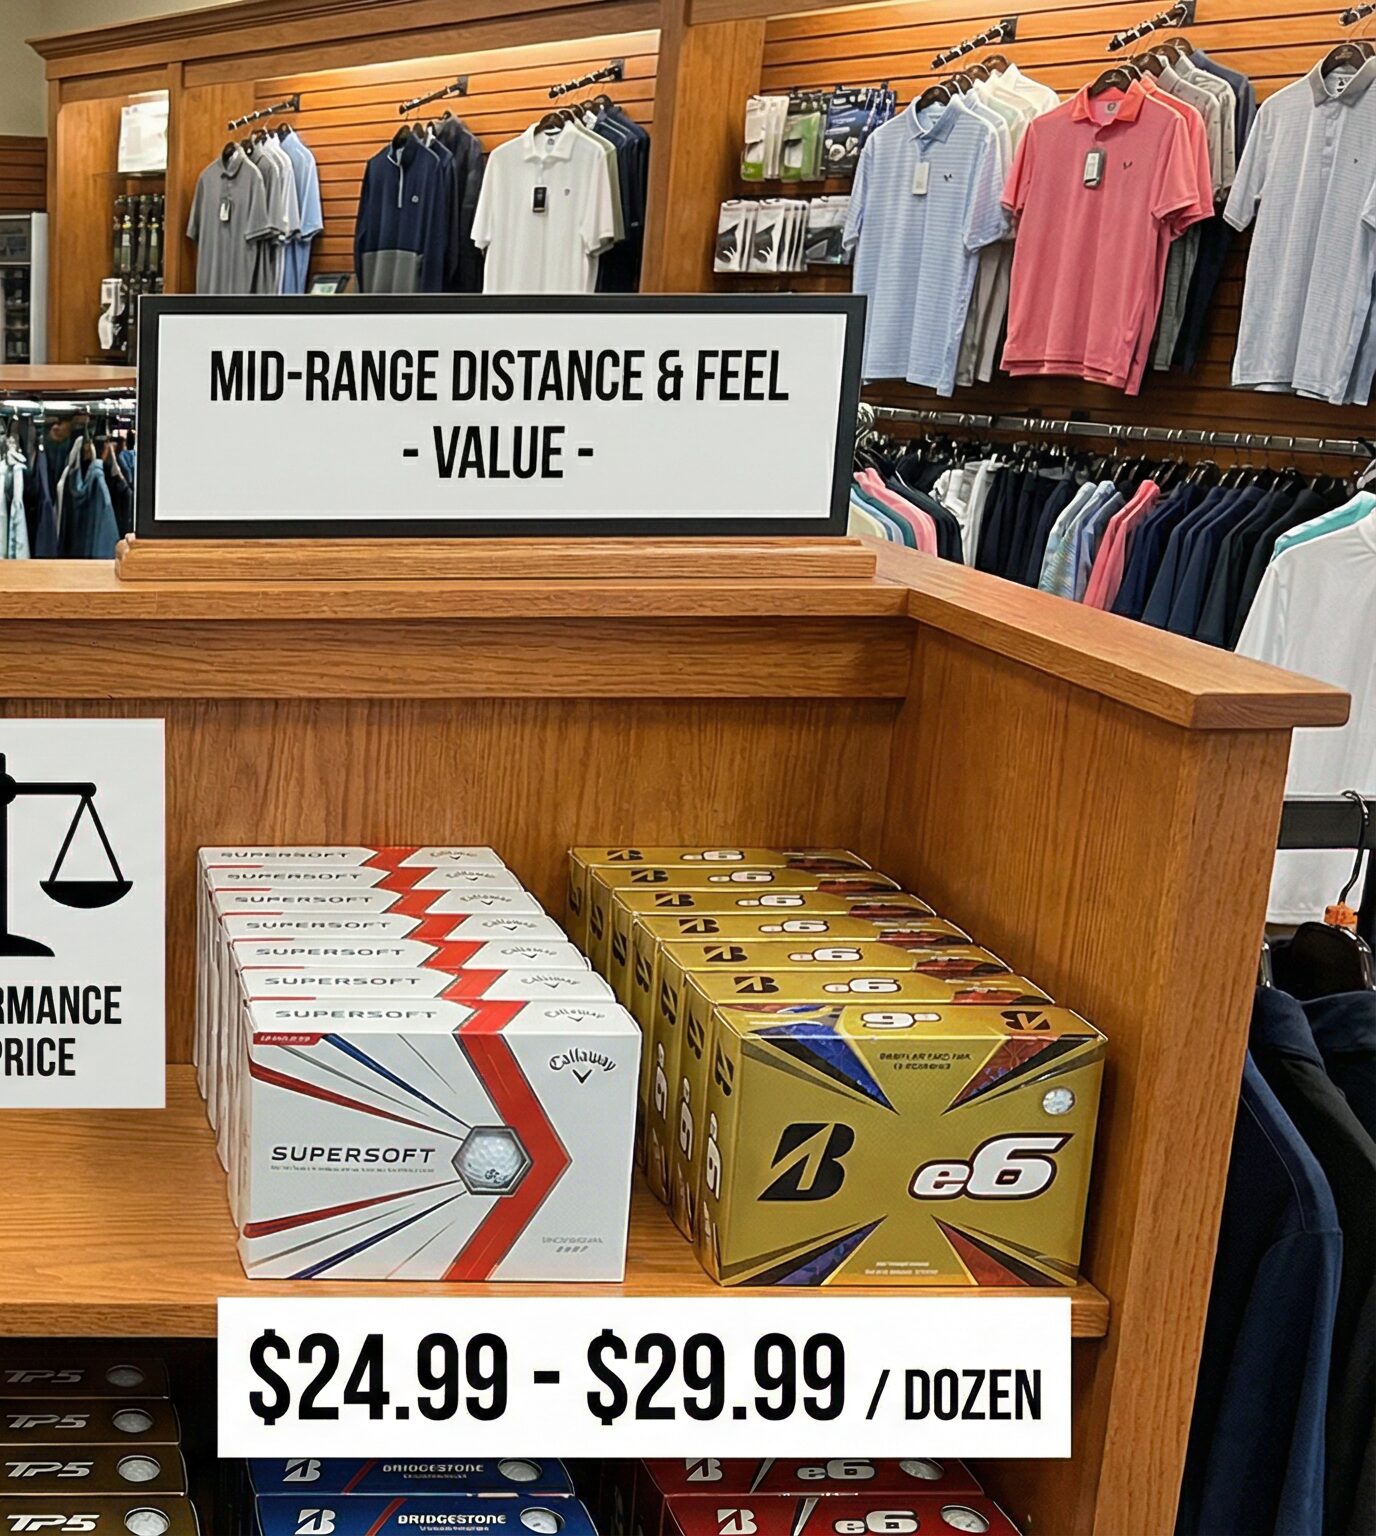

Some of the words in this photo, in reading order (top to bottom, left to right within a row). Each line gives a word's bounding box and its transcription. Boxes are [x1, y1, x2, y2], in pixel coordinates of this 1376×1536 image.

[211, 350, 438, 401] MID-RANGE
[452, 350, 644, 401] DISTANCE
[658, 350, 683, 401] &
[696, 350, 788, 400] FEEL
[433, 426, 565, 478] VALUE
[235, 896, 374, 904] SUPERSOFT
[246, 921, 391, 930] SUPERSOFT
[256, 947, 405, 957] SUPERSOFT
[265, 976, 421, 986] SUPERSOFT
[275, 1009, 436, 1019] SUPERSOFT
[550, 1048, 617, 1073] Callaway
[271, 1145, 436, 1164] SUPERSOFT
[907, 1132, 1075, 1201] e6
[5, 1369, 85, 1383] TP5
[250, 1329, 507, 1425] $24.99
[534, 1371, 559, 1383] -
[587, 1329, 844, 1425] $29.99
[866, 1370, 890, 1419] /
[906, 1369, 1041, 1420] DOZEN
[5, 1414, 90, 1429] TP5
[4, 1461, 94, 1478] TP5
[5, 1513, 100, 1532] TP5
[834, 1509, 919, 1535] e6
